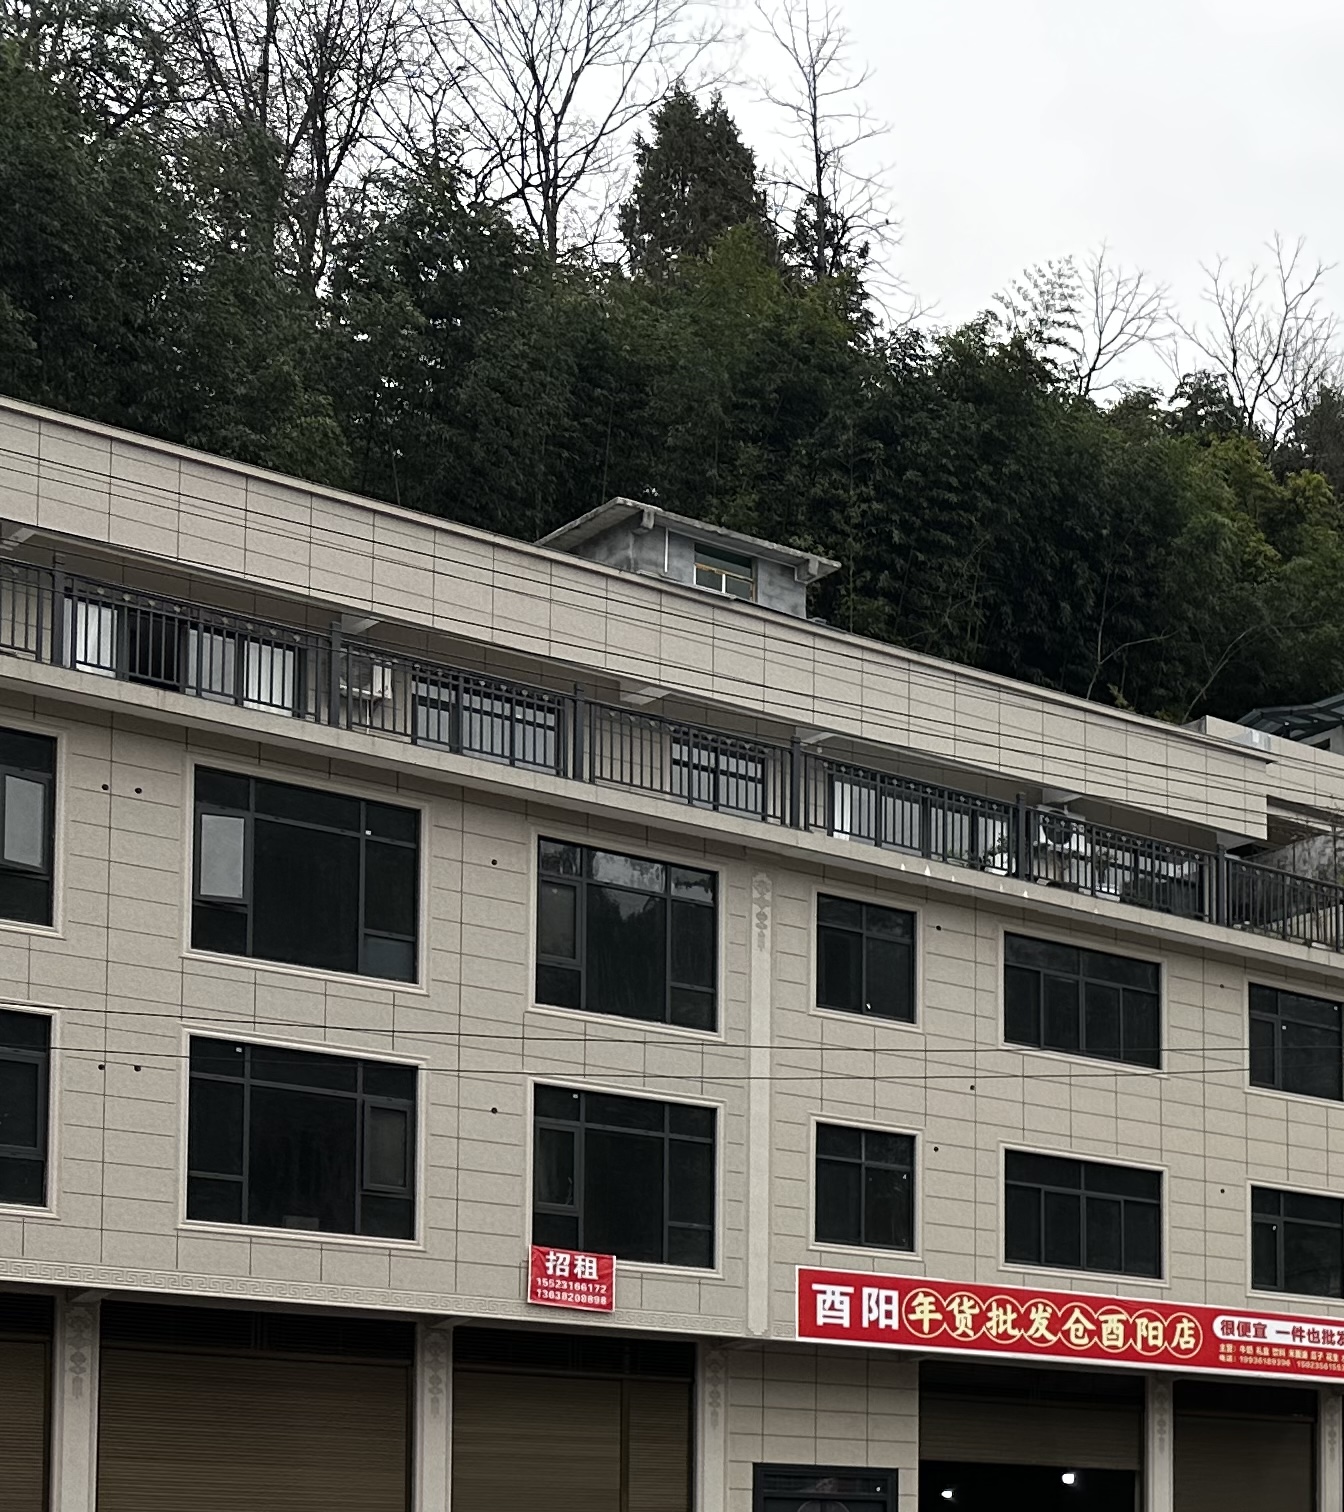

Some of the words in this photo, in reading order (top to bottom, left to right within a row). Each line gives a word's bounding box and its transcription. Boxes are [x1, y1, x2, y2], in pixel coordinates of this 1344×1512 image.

[545, 1250, 599, 1280] 招租
[1220, 1319, 1268, 1339] 很便宜
